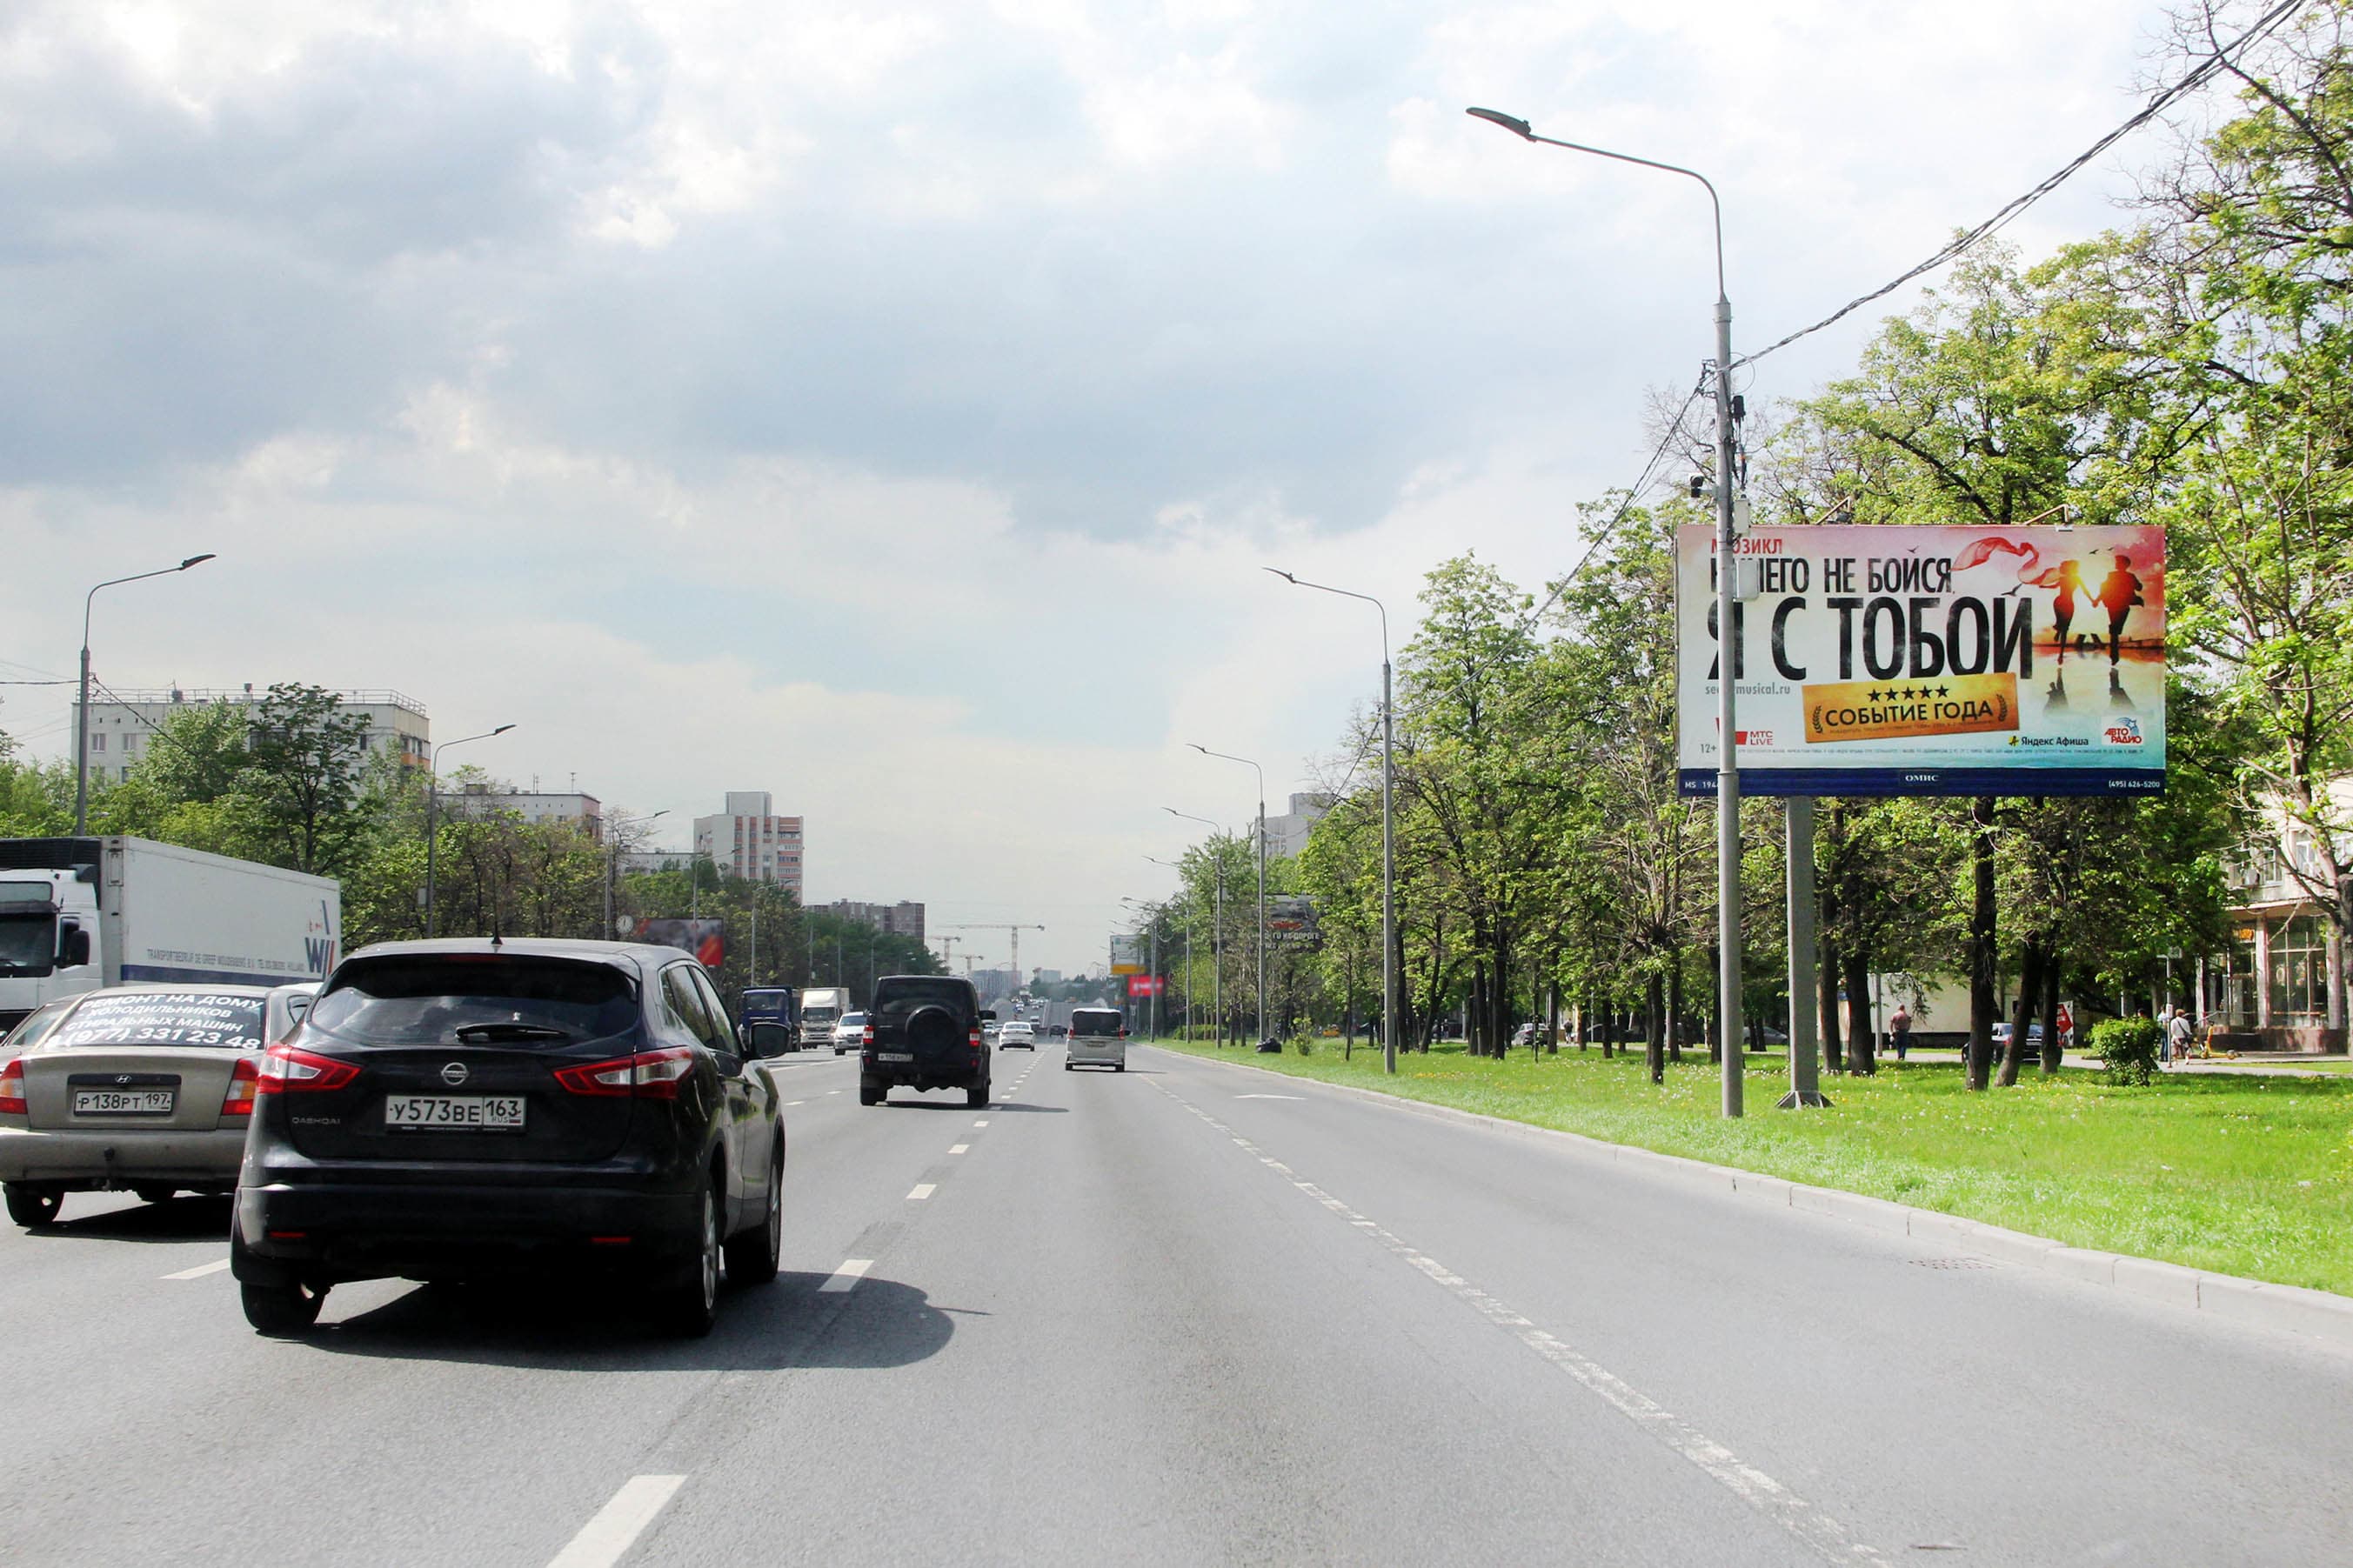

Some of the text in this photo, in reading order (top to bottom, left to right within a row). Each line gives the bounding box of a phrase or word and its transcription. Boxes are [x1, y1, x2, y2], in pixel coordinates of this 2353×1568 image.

[1710, 557, 1809, 593] ЕГО
[1823, 557, 1856, 593] НЕ
[1708, 597, 1743, 680] Я
[1771, 597, 1807, 680] С
[1705, 683, 1790, 695] semusical.ru
[1825, 704, 1928, 727] СОБЫТИЕ
[1934, 700, 1994, 722] ГОДА
[2103, 728, 2129, 737] АВТО
[2110, 736, 2142, 744] РАДИО
[1701, 744, 1717, 754] 12+
[2021, 737, 2089, 746] Яндекс Афиша
[79, 994, 264, 1011] РЕМОНТ НА ДОМУ
[87, 1004, 232, 1018] ХОЛОДИЛЬНИКОВ
[65, 1016, 244, 1032] СТИРАЛЬНЫХ МАШИН
[137, 1027, 184, 1041] 331
[186, 1031, 221, 1044] 23
[225, 1035, 261, 1050] 48
